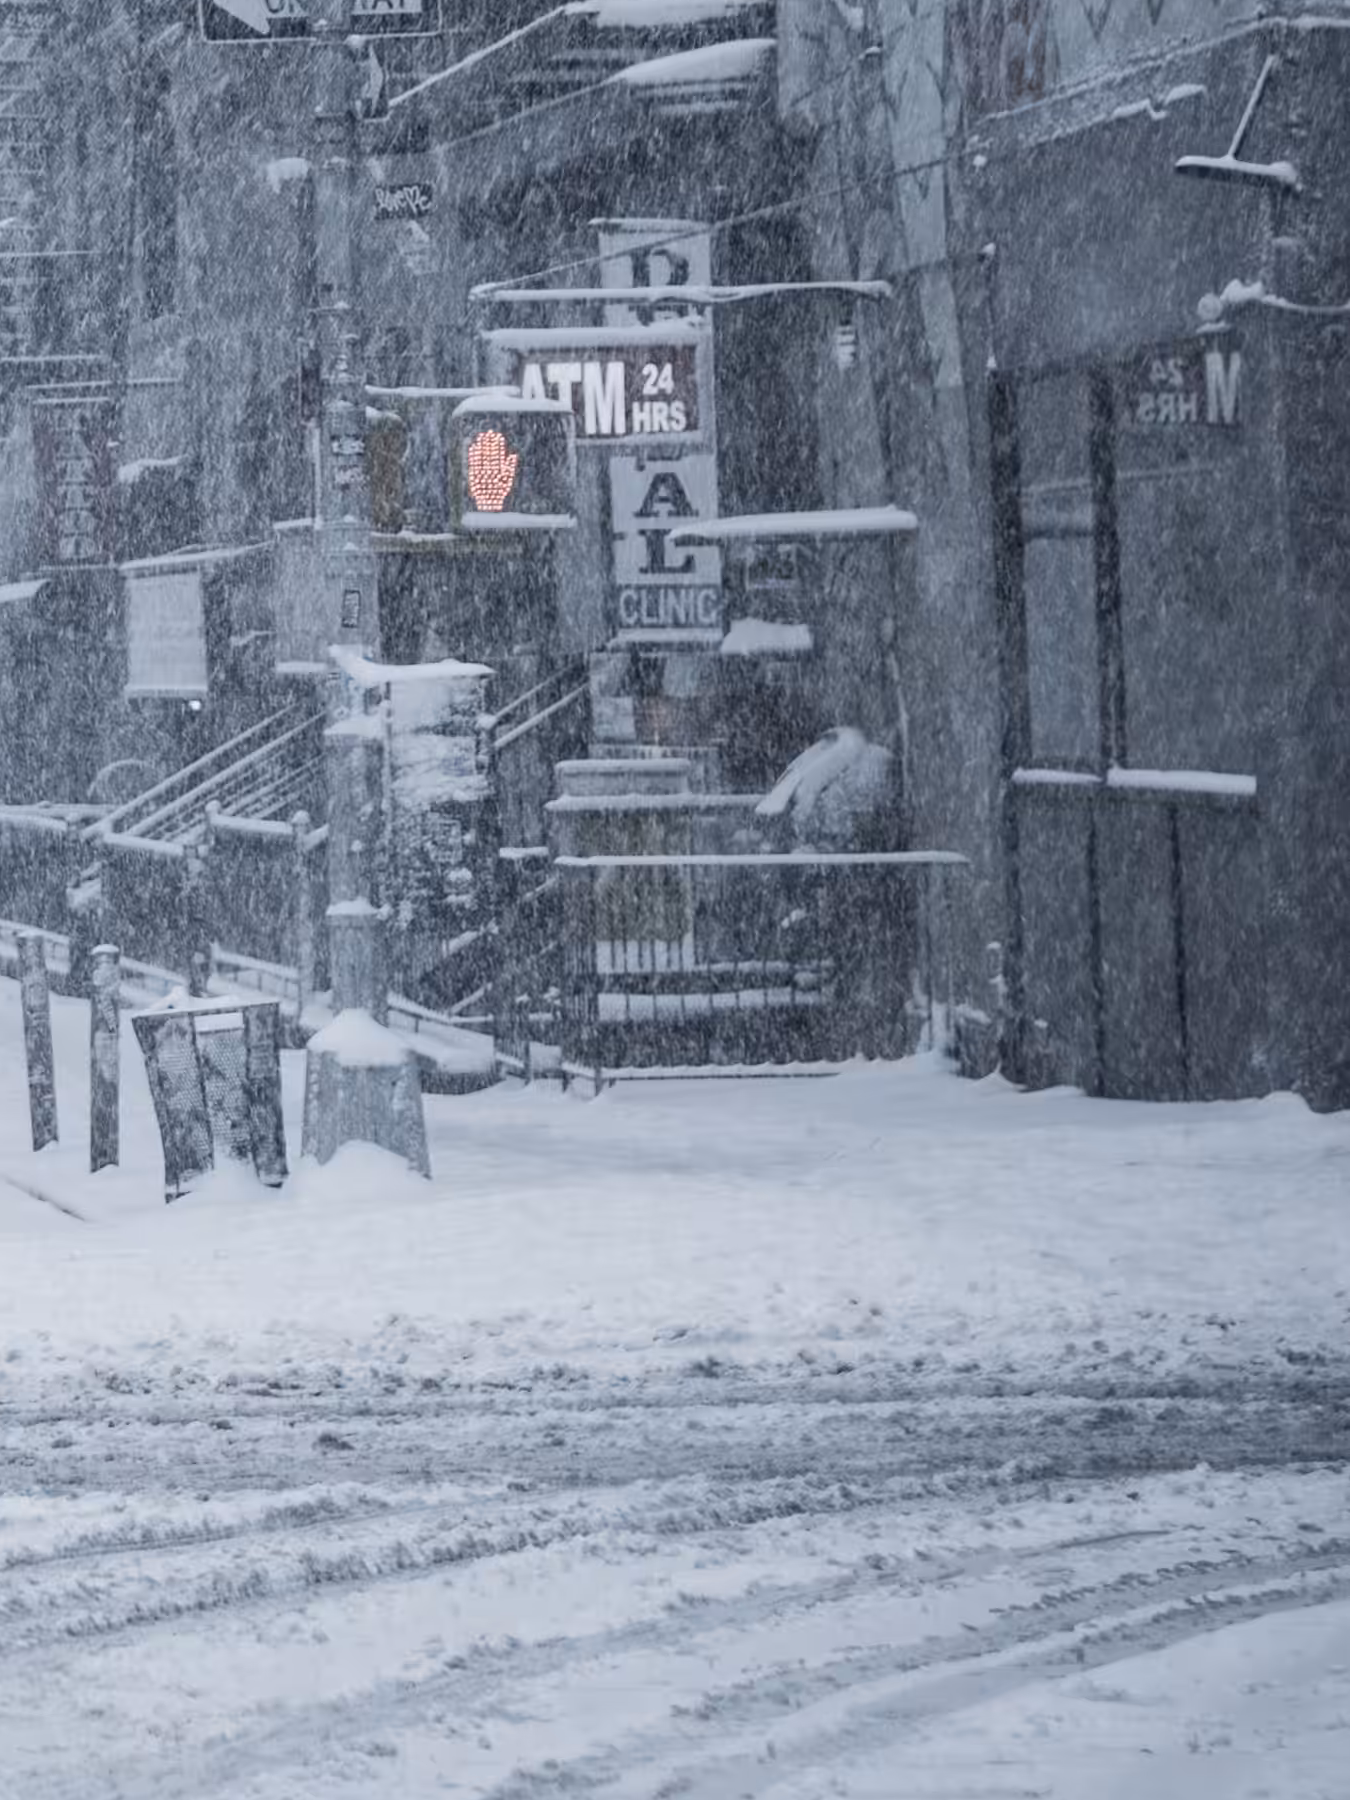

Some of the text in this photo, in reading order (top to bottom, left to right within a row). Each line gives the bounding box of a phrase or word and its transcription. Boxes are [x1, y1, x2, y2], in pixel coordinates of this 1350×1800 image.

[642, 363, 674, 395] 24
[522, 361, 626, 434] ATM
[632, 401, 687, 432] HRS
[619, 588, 718, 626] CLINIC
